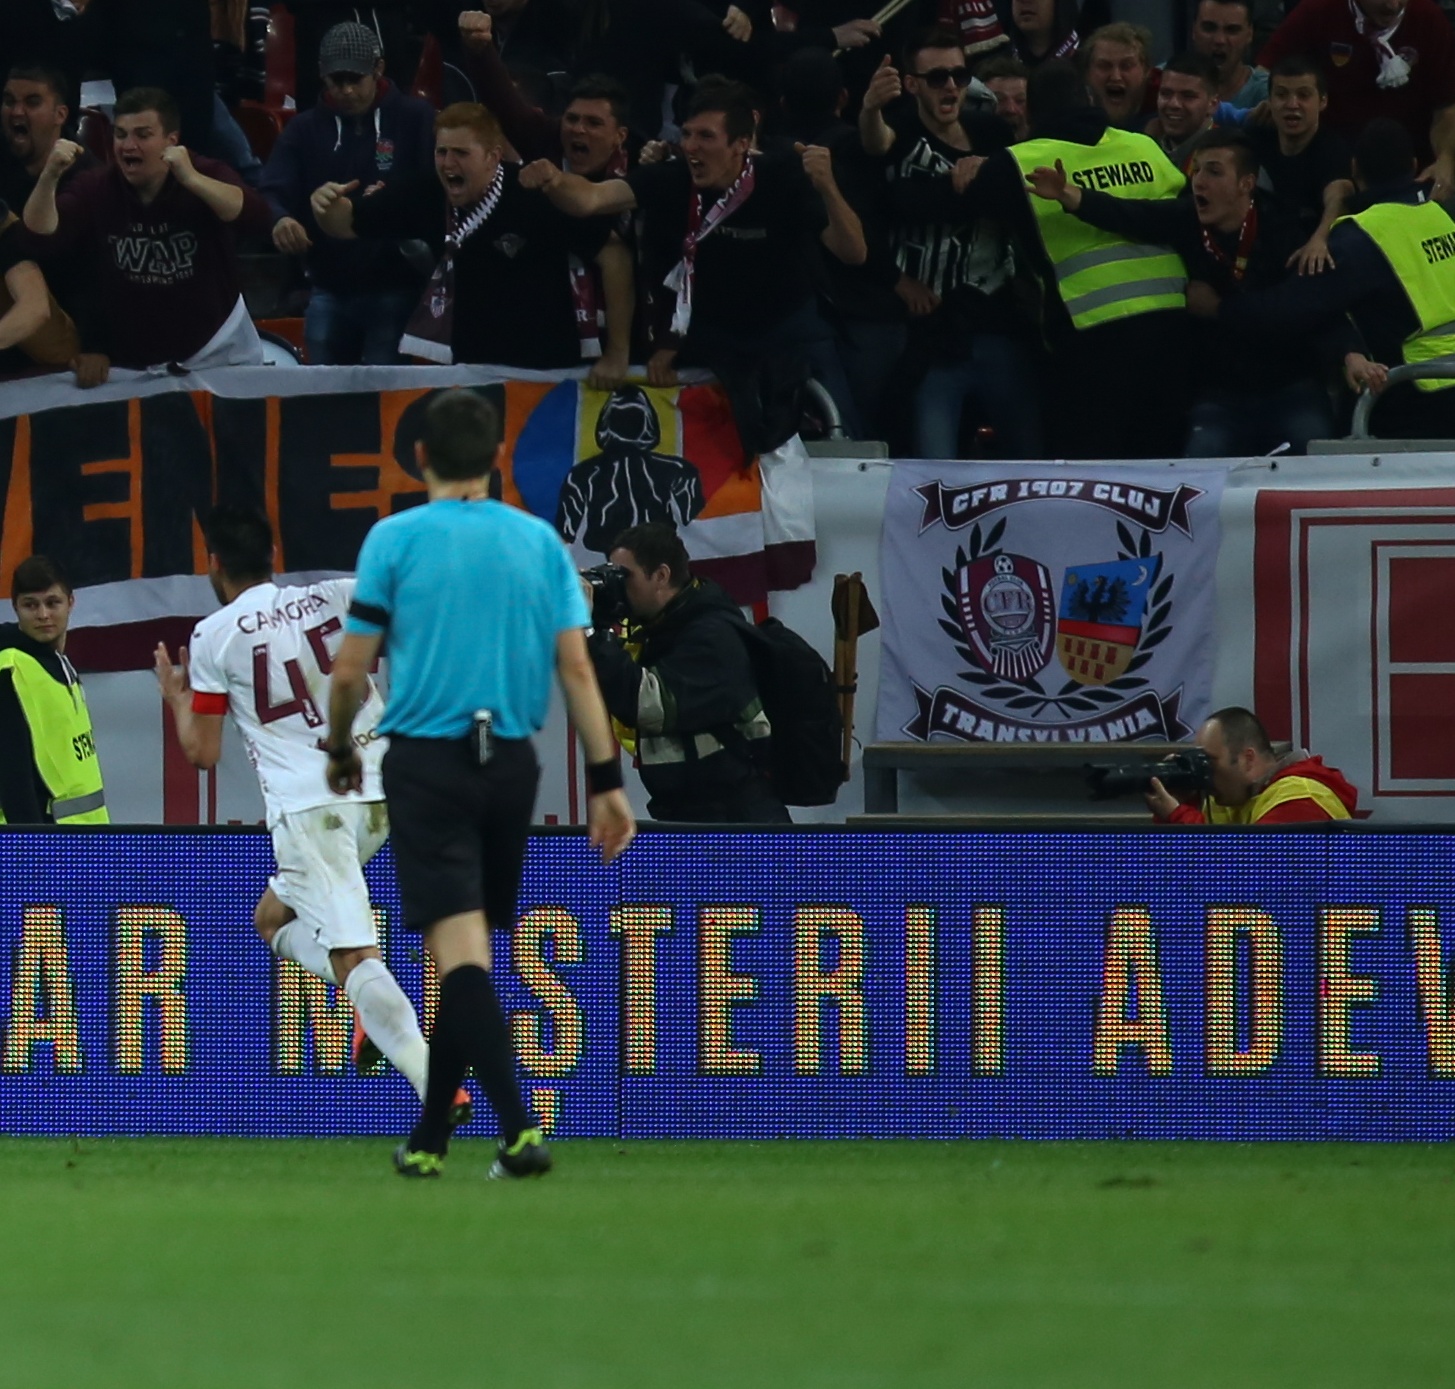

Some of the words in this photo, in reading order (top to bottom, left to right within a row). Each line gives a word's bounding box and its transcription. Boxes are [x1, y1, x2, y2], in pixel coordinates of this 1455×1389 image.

[1073, 162, 1155, 189] STEWARD
[952, 482, 1008, 514] CFR
[1017, 480, 1084, 498] 1907
[1093, 483, 1160, 517] CLUJ
[238, 596, 329, 634] CAMORA
[984, 590, 1033, 613] CFR
[942, 703, 1158, 742] TRANSYLVANIA
[274, 903, 1006, 1137] MȘTERII
[1091, 904, 1455, 1078] ADEV
